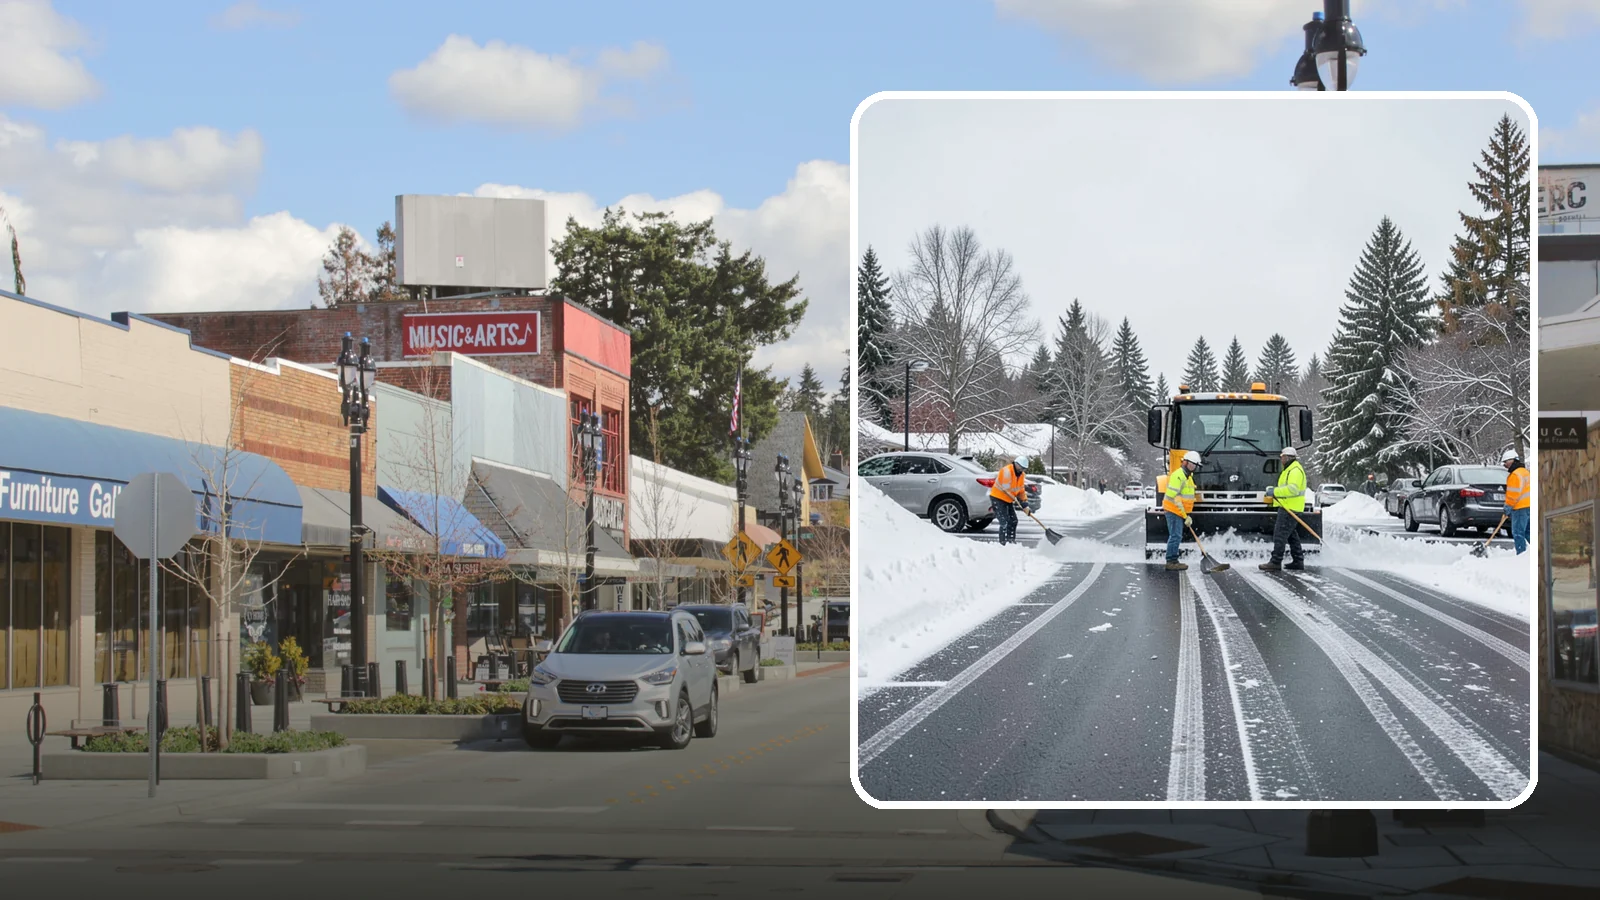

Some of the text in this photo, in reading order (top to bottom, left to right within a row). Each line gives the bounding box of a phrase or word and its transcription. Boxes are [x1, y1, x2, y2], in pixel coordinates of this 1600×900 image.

[0, 471, 122, 519] Furniture Gal
[454, 563, 479, 574] SUSHI
